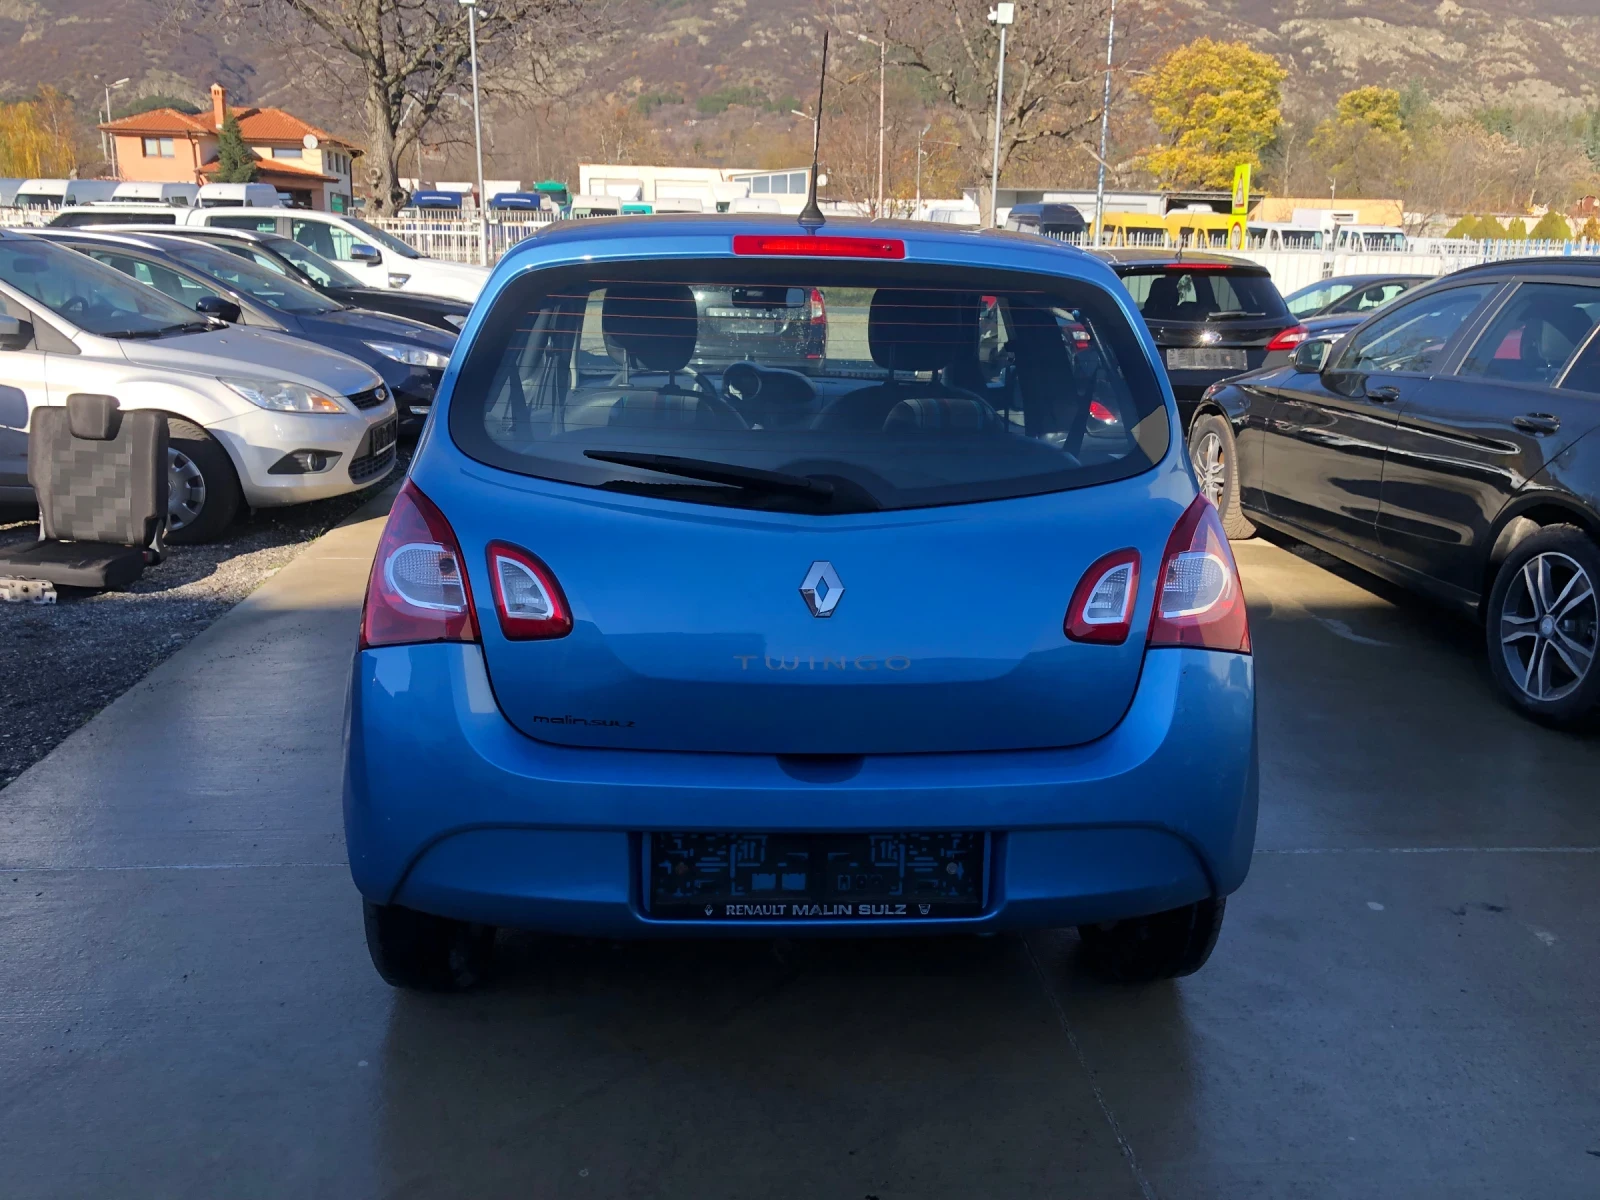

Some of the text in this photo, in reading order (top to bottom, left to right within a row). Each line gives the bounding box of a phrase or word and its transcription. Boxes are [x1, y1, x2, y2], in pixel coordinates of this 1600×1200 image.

[733, 655, 911, 671] TWINGO
[725, 904, 906, 916] RENAULT MALIN SULZ
